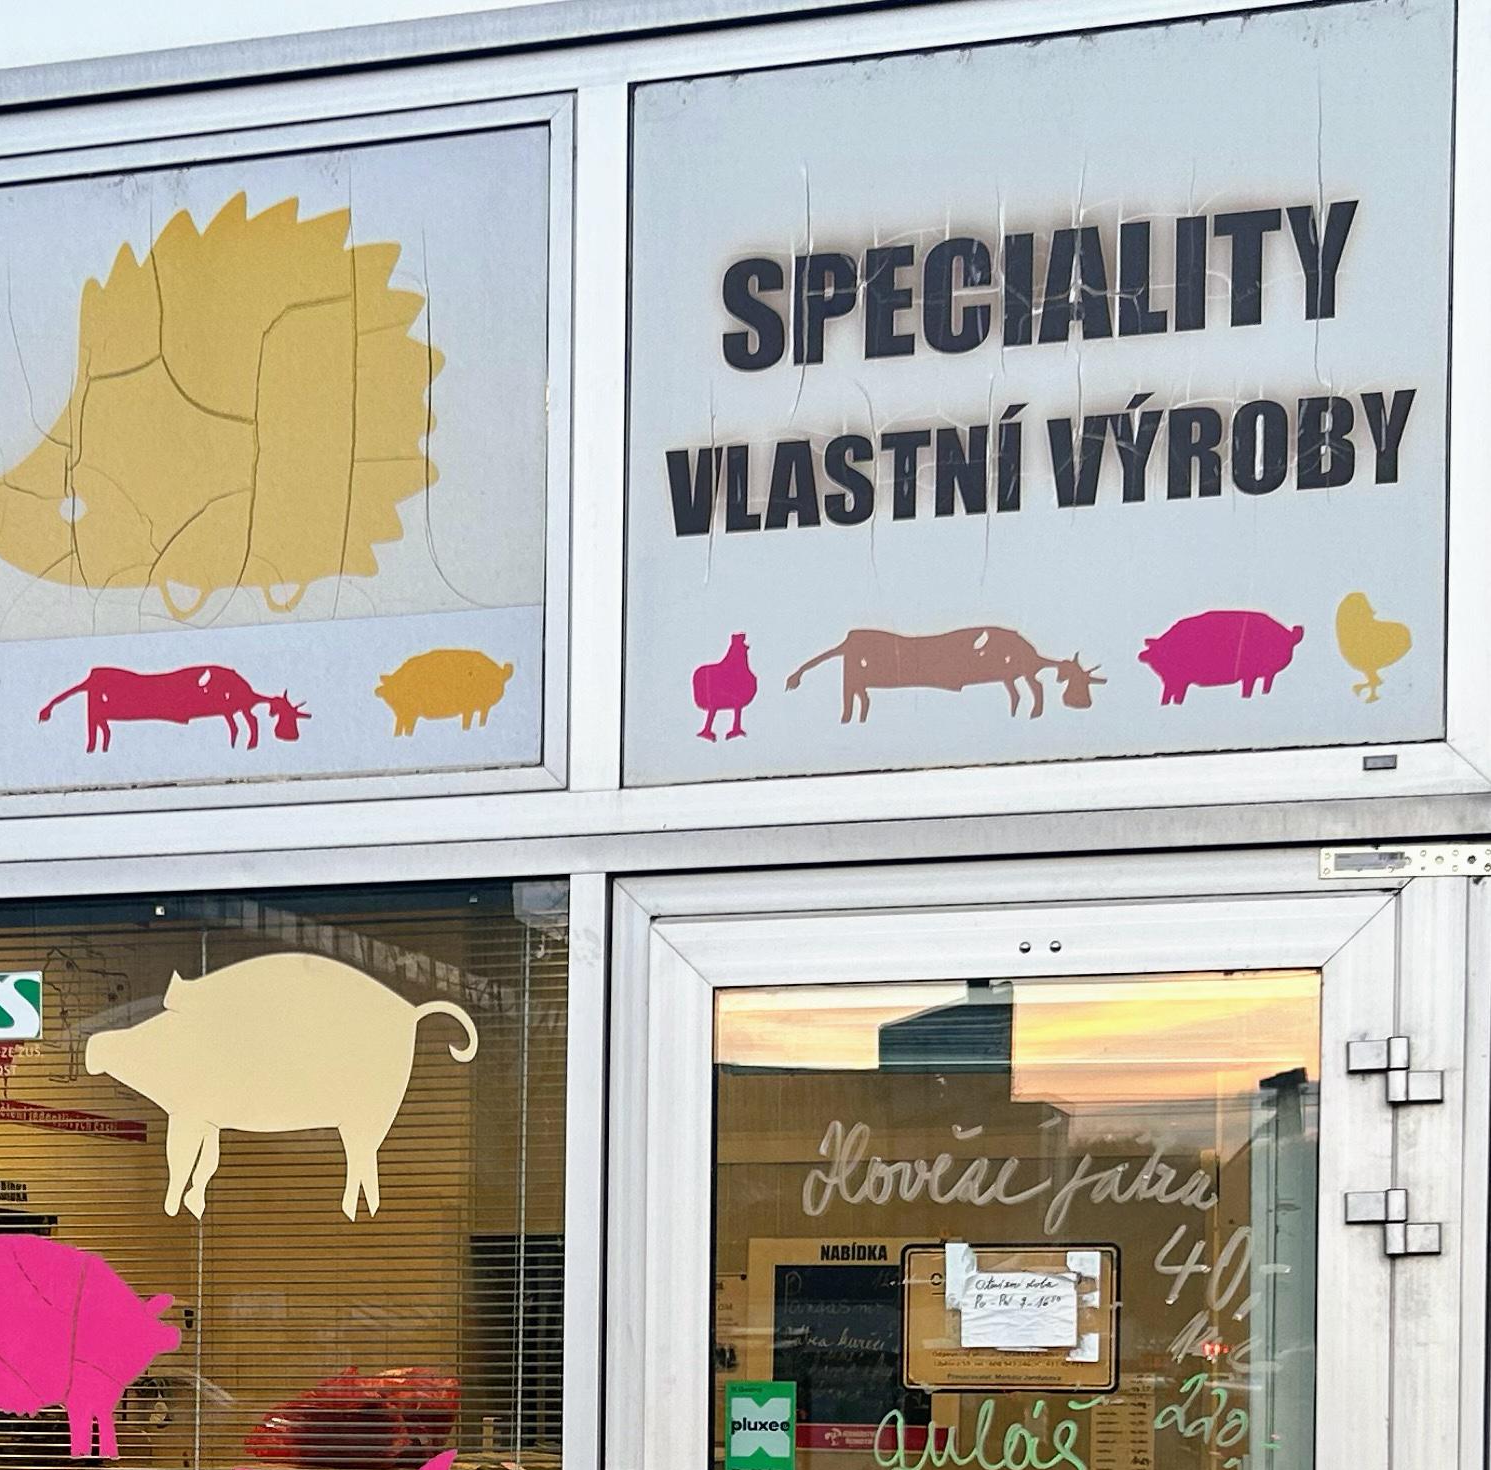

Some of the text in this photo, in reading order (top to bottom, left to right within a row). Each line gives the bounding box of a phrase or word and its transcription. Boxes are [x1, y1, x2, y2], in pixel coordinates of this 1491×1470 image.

[721, 200, 1359, 372] SPECIALITY
[665, 388, 1417, 537] VLASTNÍ VÝROBY
[820, 1242, 888, 1261] NABÍDKA
[731, 1417, 790, 1434] pluxee
